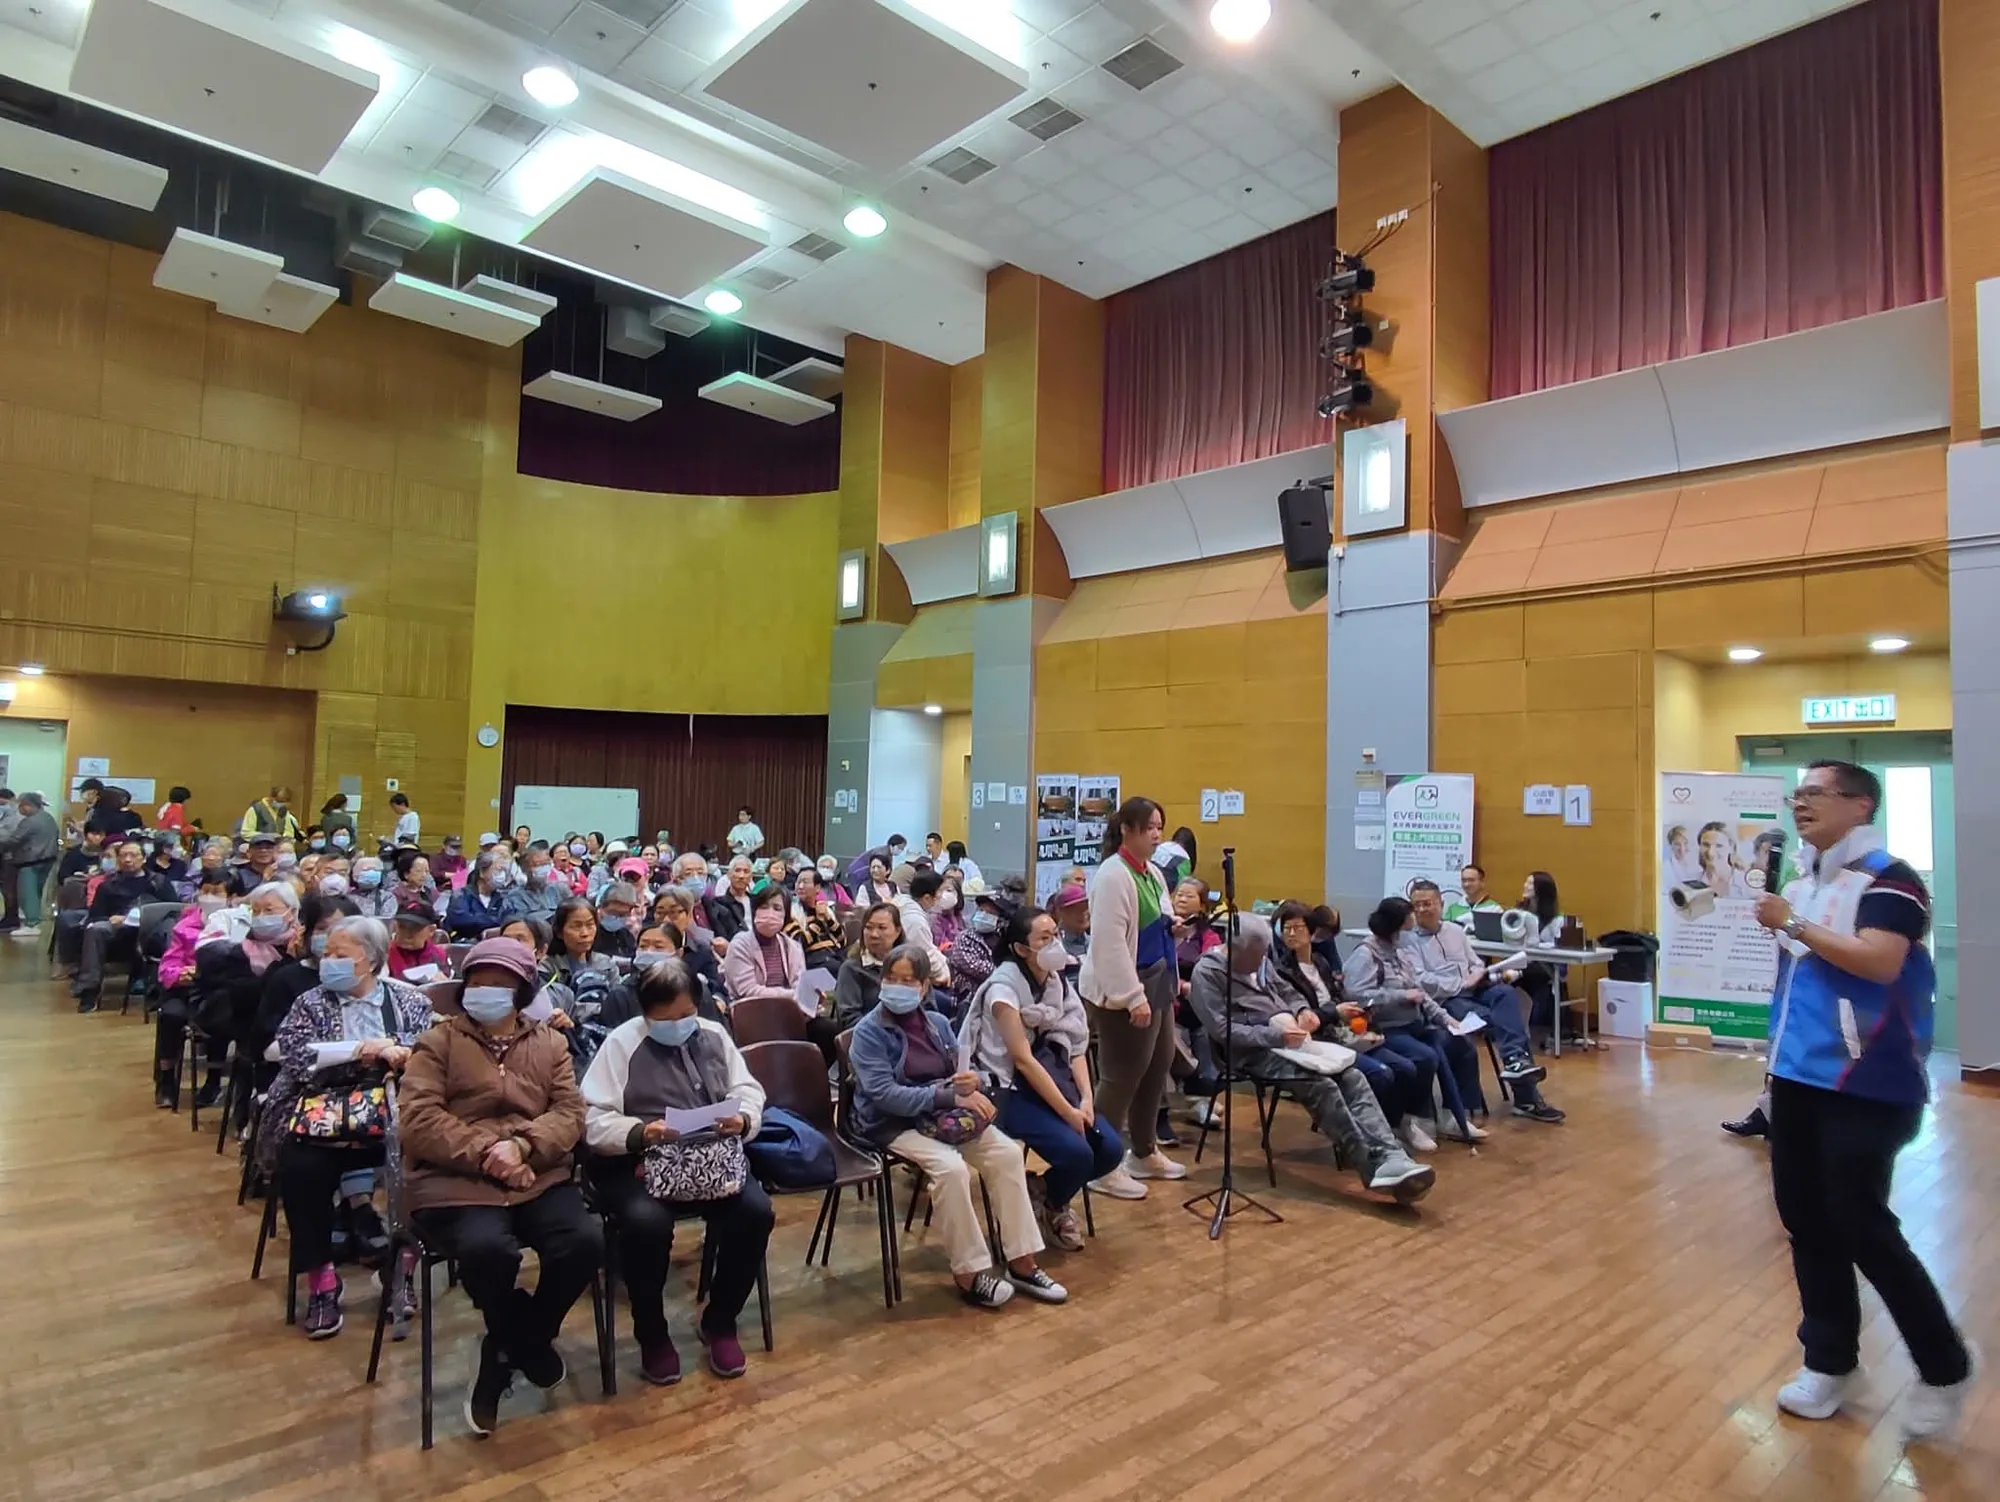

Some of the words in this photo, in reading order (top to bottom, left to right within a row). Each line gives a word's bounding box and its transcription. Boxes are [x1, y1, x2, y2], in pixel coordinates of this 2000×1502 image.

[1811, 700, 1849, 719] EXIT
[1855, 699, 1884, 717] 出口
[849, 796, 856, 811] 4
[974, 789, 983, 806] 3
[1204, 798, 1216, 818] 2
[1393, 811, 1461, 821] EVERGREEN
[1570, 796, 1581, 821] 1
